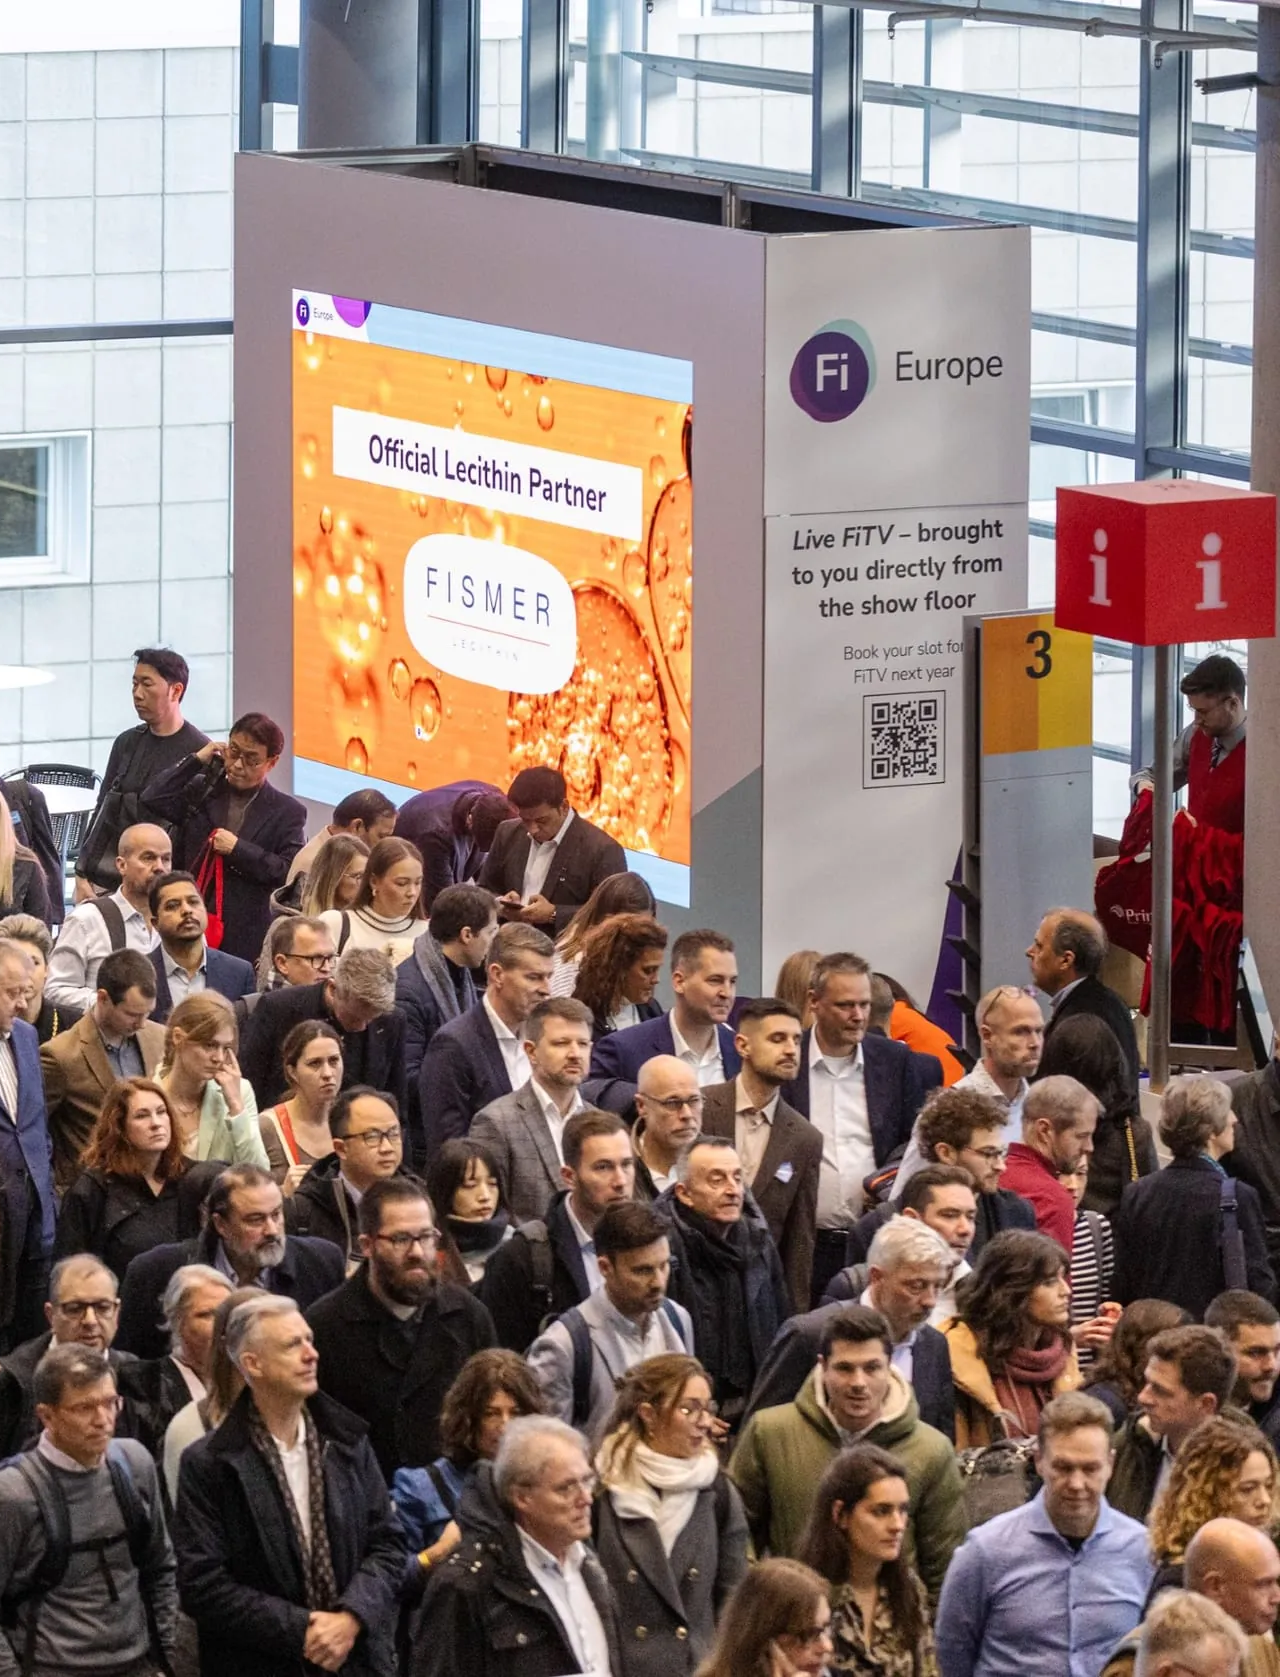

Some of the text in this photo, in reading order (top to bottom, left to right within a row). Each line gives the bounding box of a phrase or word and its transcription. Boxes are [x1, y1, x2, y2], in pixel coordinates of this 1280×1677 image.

[816, 350, 1003, 392] Fi Europe
[369, 434, 607, 512] Official Lecithin Partner
[792, 528, 835, 550] Live
[842, 524, 895, 547] FiTV
[918, 519, 1003, 544] brought
[792, 554, 1003, 588] to you directly from
[426, 566, 551, 627] FISMER
[819, 590, 976, 618] the show floor
[843, 641, 879, 661] Book
[882, 645, 913, 661] your
[917, 640, 943, 656] slot
[1025, 630, 1052, 679] 3
[854, 666, 955, 684] FiTV next year
